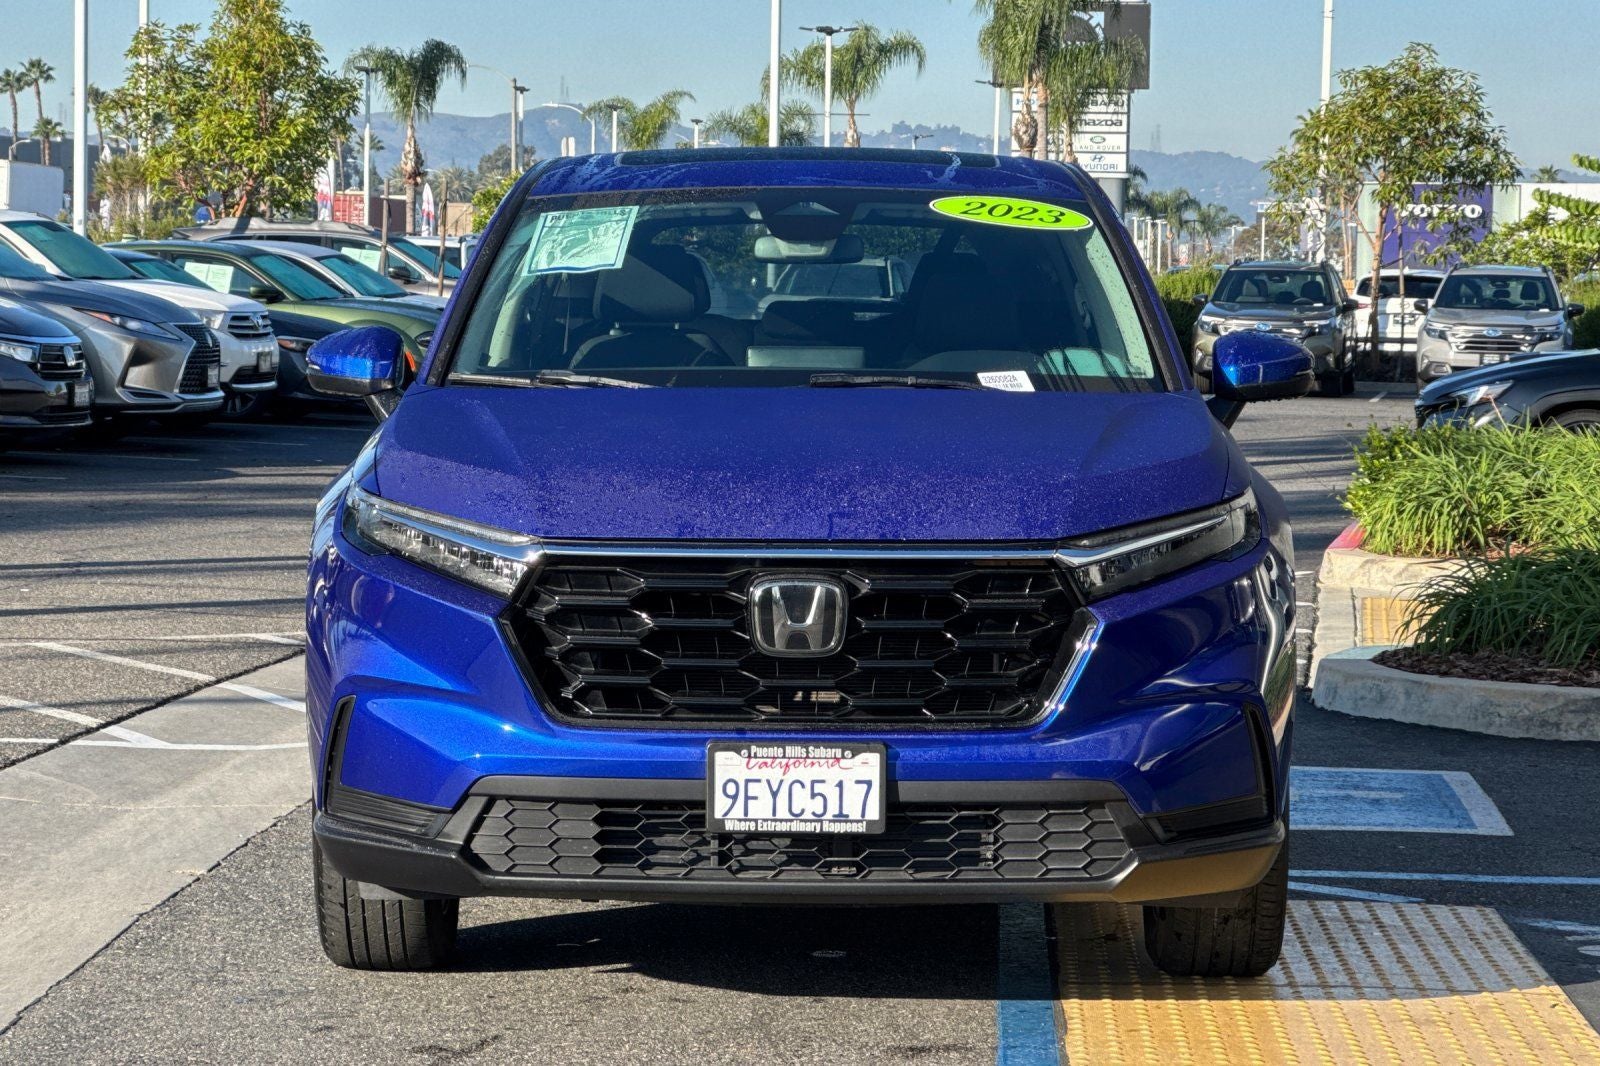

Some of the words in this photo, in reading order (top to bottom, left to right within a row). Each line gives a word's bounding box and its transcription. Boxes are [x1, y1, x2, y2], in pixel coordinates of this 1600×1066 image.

[960, 201, 1066, 224] 2023
[750, 746, 784, 758] Puente
[786, 746, 806, 758] Hills
[808, 746, 842, 758] Subaru
[746, 757, 853, 776] California
[721, 778, 873, 819] 9FYC517
[724, 820, 755, 831] Where
[758, 820, 821, 833] Extraordinary
[822, 820, 866, 833] Happens!
